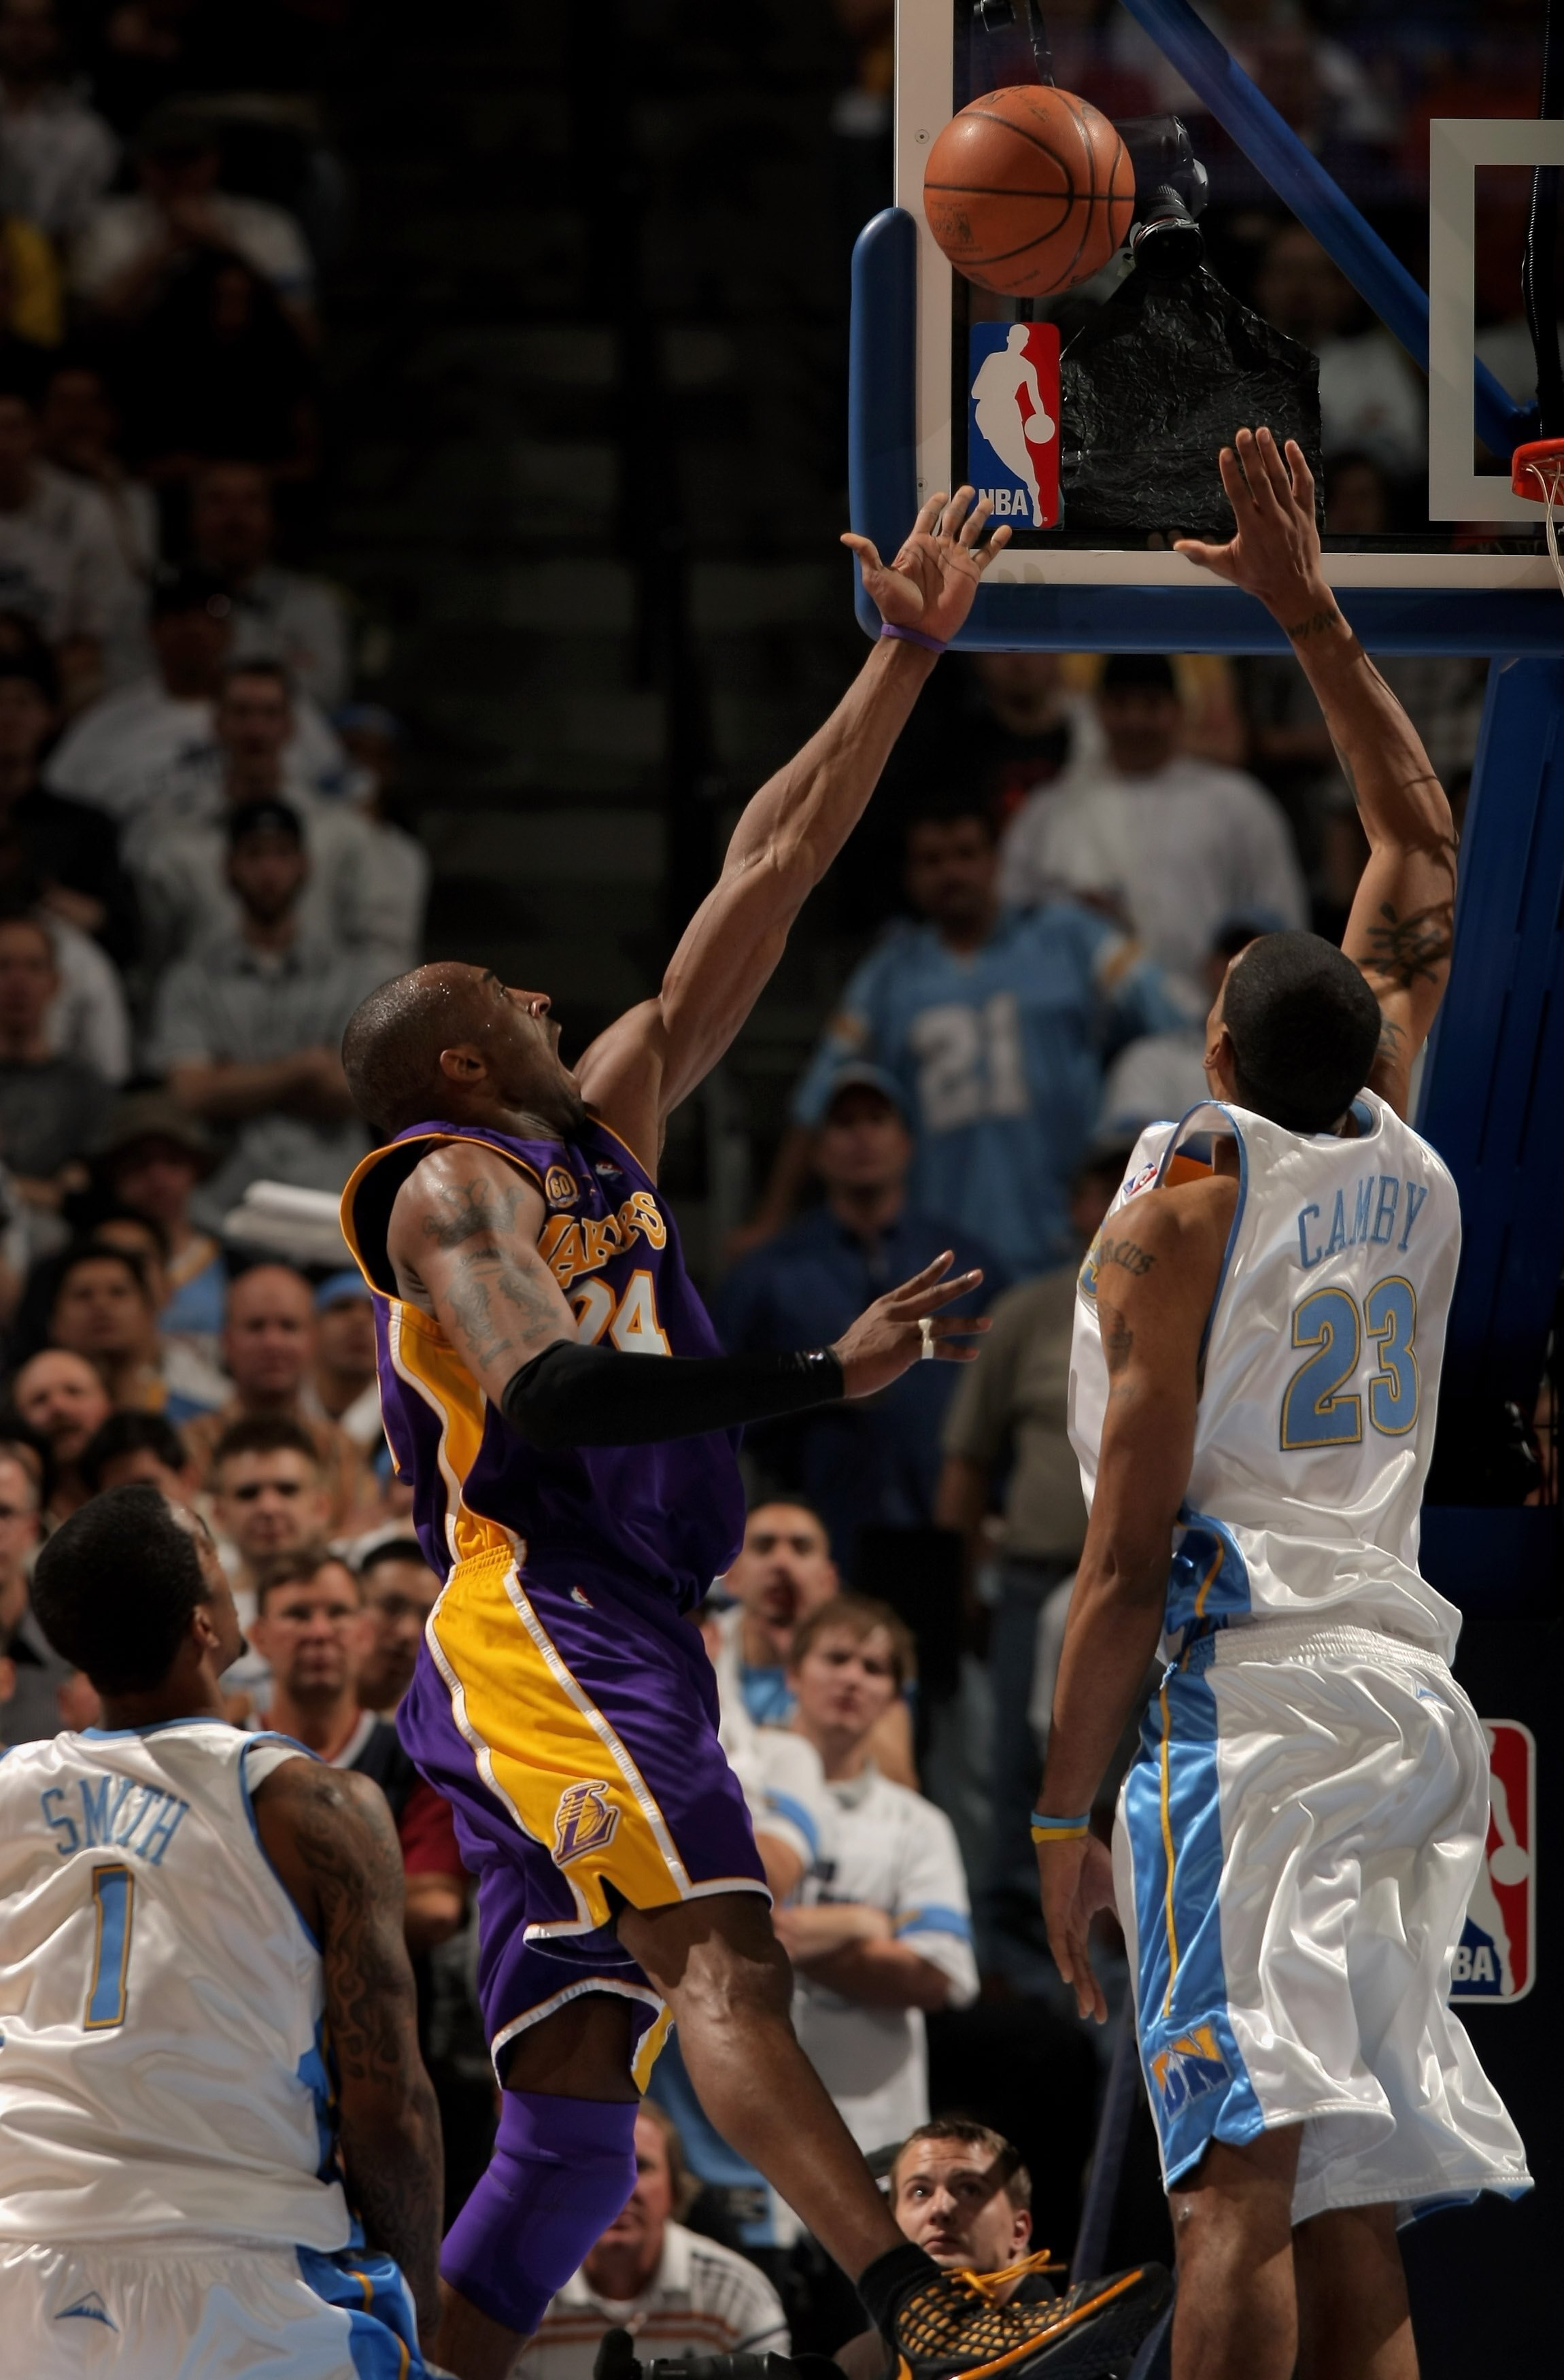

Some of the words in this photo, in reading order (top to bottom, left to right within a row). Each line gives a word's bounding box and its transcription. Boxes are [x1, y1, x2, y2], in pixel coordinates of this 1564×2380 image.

[979, 488, 1029, 515] NBA
[908, 993, 1031, 1134] 21
[550, 1174, 571, 1199] 60
[1297, 1175, 1428, 1269] CAMBY
[535, 1191, 667, 1289] LAKRS
[1280, 1275, 1420, 1451] 23
[41, 1775, 190, 1866] SMITH
[84, 1864, 135, 2031] 1
[1450, 1945, 1497, 1982] BA
